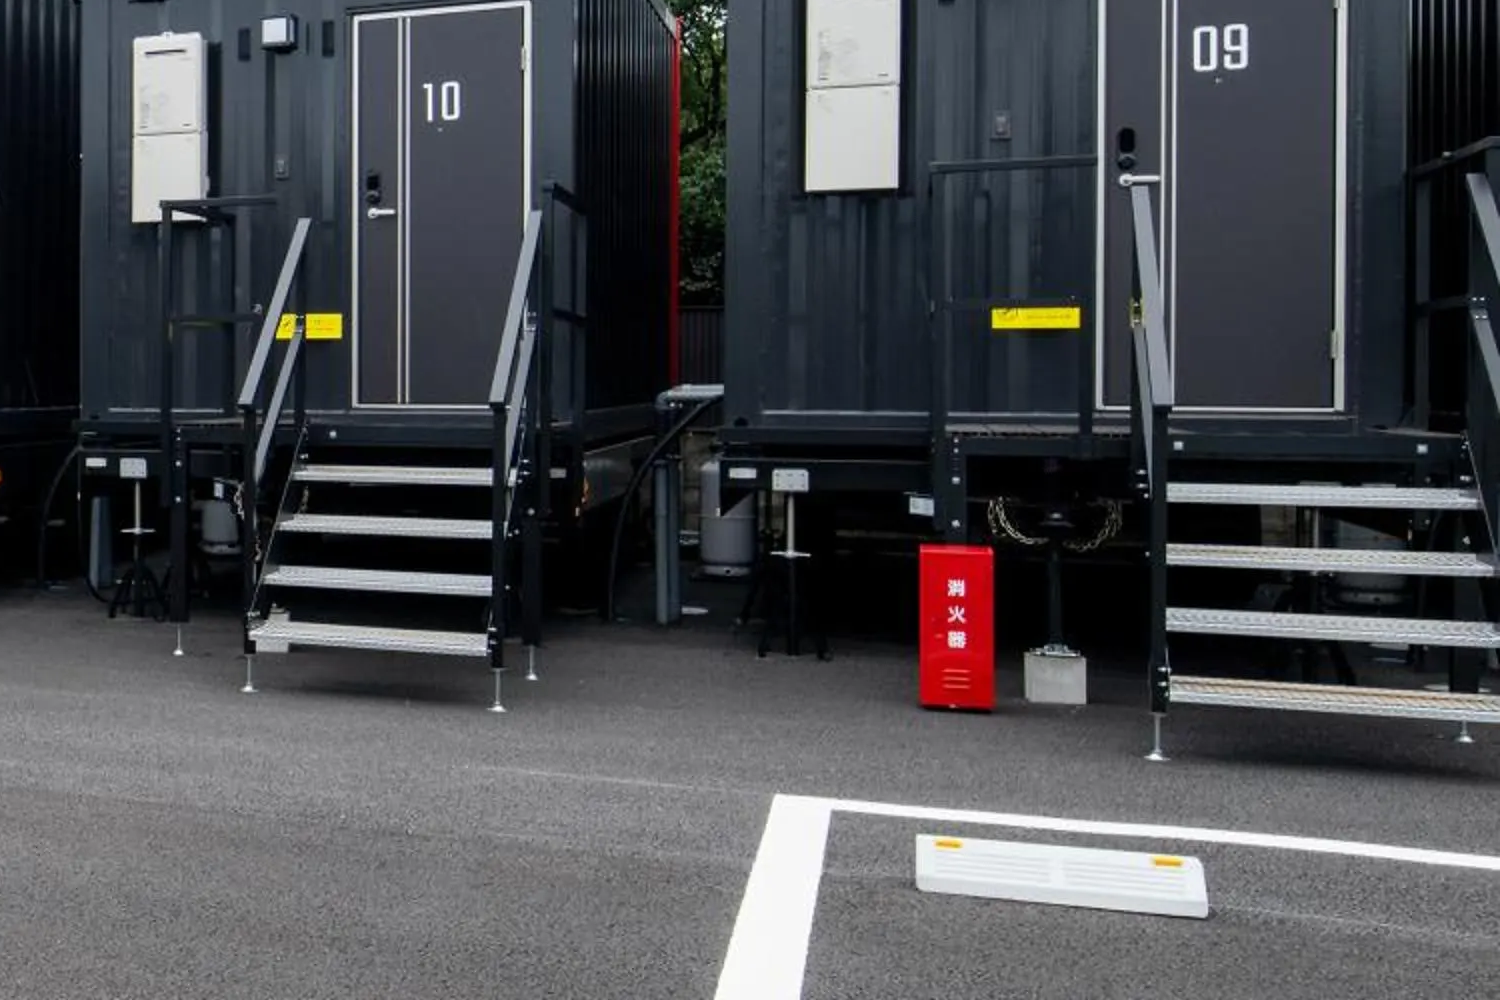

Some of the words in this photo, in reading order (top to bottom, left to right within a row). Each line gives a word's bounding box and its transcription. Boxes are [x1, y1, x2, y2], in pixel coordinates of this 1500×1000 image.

[1192, 23, 1249, 73] 09
[423, 80, 461, 123] 10
[947, 578, 967, 650] 消火器
